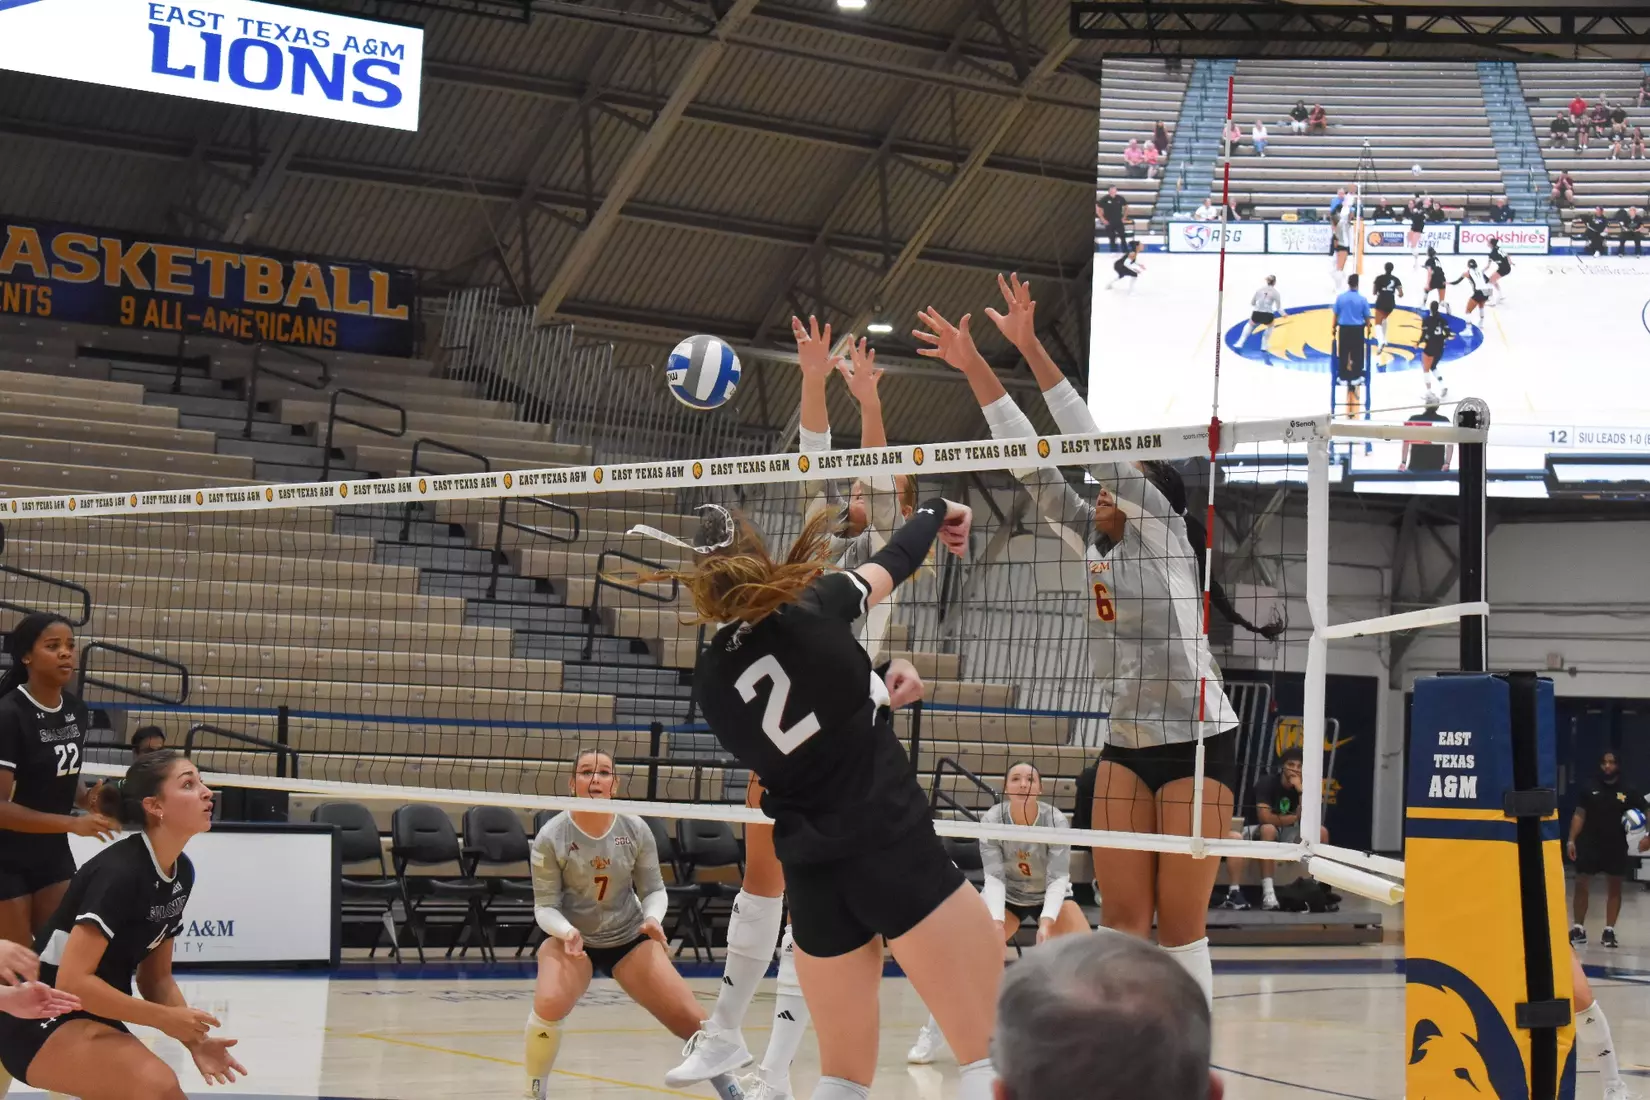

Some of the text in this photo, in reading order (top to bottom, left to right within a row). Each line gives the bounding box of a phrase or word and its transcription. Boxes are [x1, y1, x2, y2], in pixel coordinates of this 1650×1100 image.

[148, 2, 405, 60] EAST TEXAS A&M
[148, 23, 402, 109] LIONS
[1428, 231, 1452, 241] PLACE
[1461, 229, 1545, 243] Brookshire's
[0, 225, 408, 320] ASKETBALL
[0, 278, 52, 316] NTS
[120, 295, 338, 348] 9 ALL-AMERICANS
[1061, 434, 1162, 455] EAST TEXAS A&M
[1549, 430, 1568, 443] 12
[1579, 432, 1594, 443] SIU
[1596, 433, 1626, 444] LEADS
[1629, 434, 1642, 444] 1-0
[818, 451, 903, 469] EAST TEXAS A&M
[934, 443, 1027, 461] EAST TEXAS A&M
[611, 466, 685, 481] EAST TEXAS A&M
[710, 459, 790, 475] EAST TEXAS A&M
[433, 476, 497, 491] EAST TEXAS A&M
[519, 471, 587, 486] EAST TEXAS A&M
[353, 485, 371, 495] EAST
[374, 483, 395, 494] TEXAS
[1093, 583, 1115, 621] 6
[734, 654, 821, 755] 2
[1438, 731, 1472, 746] EAST
[54, 742, 79, 776] 22
[1433, 754, 1475, 769] TEXAS
[1428, 775, 1478, 799] A&M
[593, 875, 609, 902] 7
[186, 919, 235, 937] A&M
